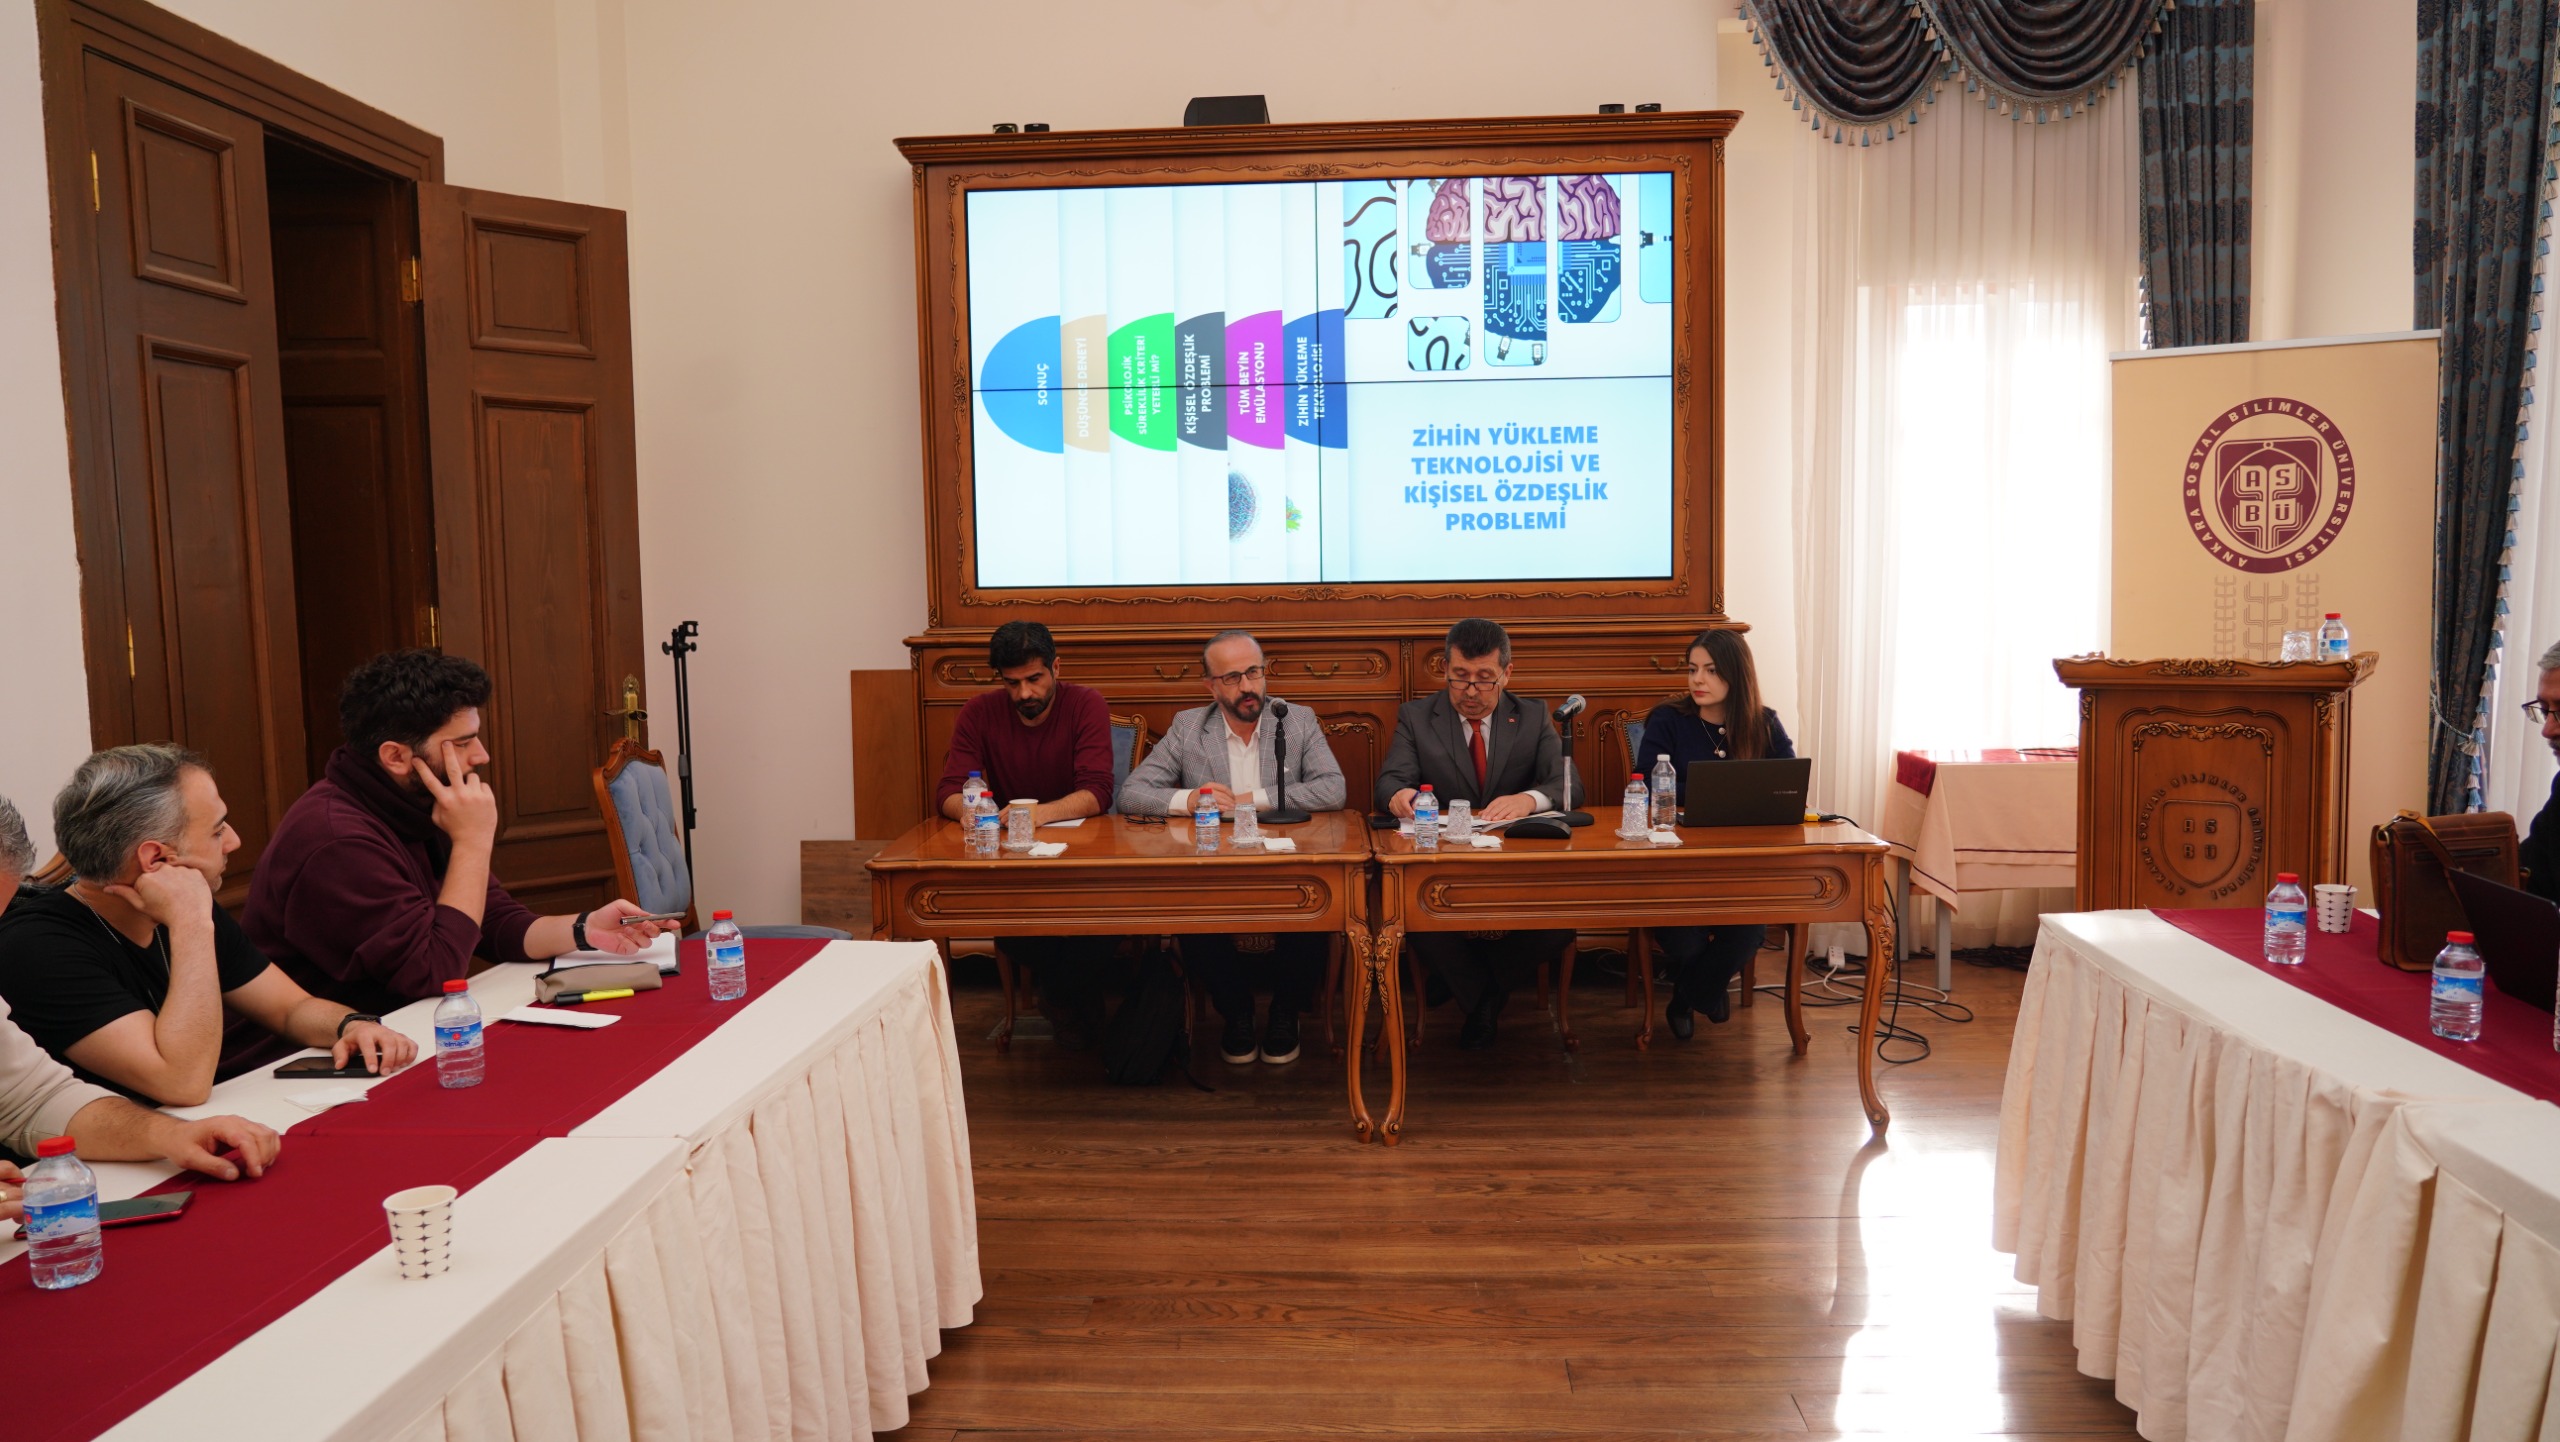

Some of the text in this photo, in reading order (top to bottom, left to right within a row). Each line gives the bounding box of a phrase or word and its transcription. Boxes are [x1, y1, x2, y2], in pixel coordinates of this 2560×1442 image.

[1036, 363, 1050, 406] SONUÇ
[1075, 337, 1091, 438] DÜŞÜNCE DENEYİ
[1121, 355, 1133, 416] PSİKOLOJİK
[1134, 335, 1148, 435] SÜREKLİLİK KRİTERİ
[1149, 375, 1162, 415] YETERLİ
[1182, 333, 1200, 435] KİŞİSEL ÖZDEŞLİK
[1199, 354, 1212, 413] PROBLEMİ
[1236, 351, 1251, 416] TÜM BEYİN
[1253, 341, 1267, 424] EMÜLASYONU
[1295, 336, 1309, 427] ZİHİN YÜKLEME
[1411, 450, 1600, 475] TEKNOLOJİSİ VE
[1412, 422, 1599, 446] ZİHİN YÜKLEME
[1404, 477, 1609, 508] KİŞİSEL ÖZDEŞLİK
[2186, 399, 2354, 568] ANKARA SOSYAL BİLİMLER ÜNİVERSİTESİ
[1445, 506, 1566, 531] PROBLEMİ
